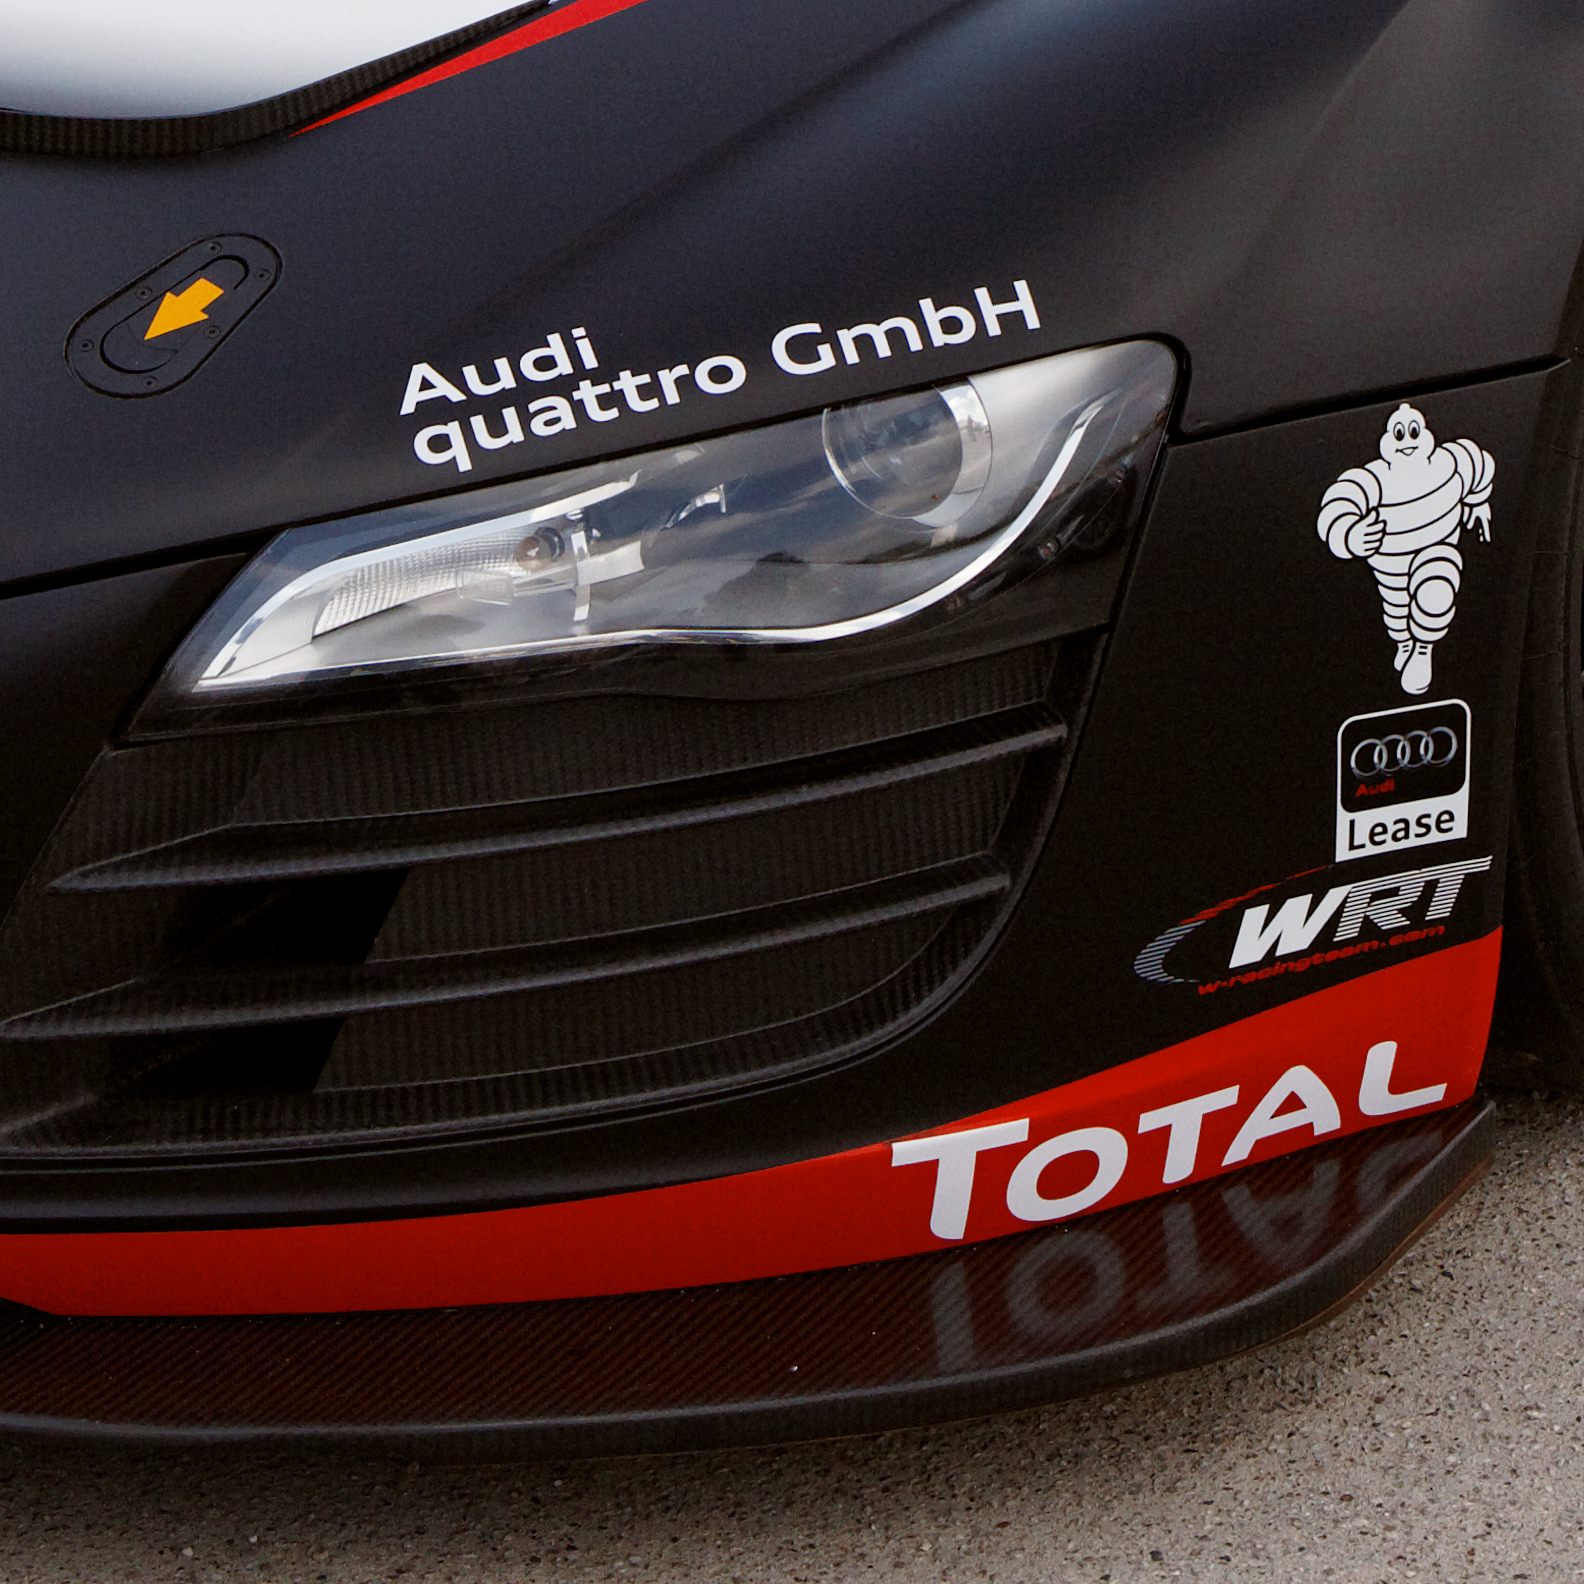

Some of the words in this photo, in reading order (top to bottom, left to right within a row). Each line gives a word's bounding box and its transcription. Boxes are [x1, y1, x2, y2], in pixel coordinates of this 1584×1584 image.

[399, 326, 599, 416] Audi
[413, 354, 748, 473] quattro
[770, 279, 1041, 376] GmbH
[1348, 810, 1455, 852] Lease
[1355, 779, 1395, 797] Audi
[1229, 856, 1493, 969] WRT
[892, 1040, 1448, 1240] TOTAL
